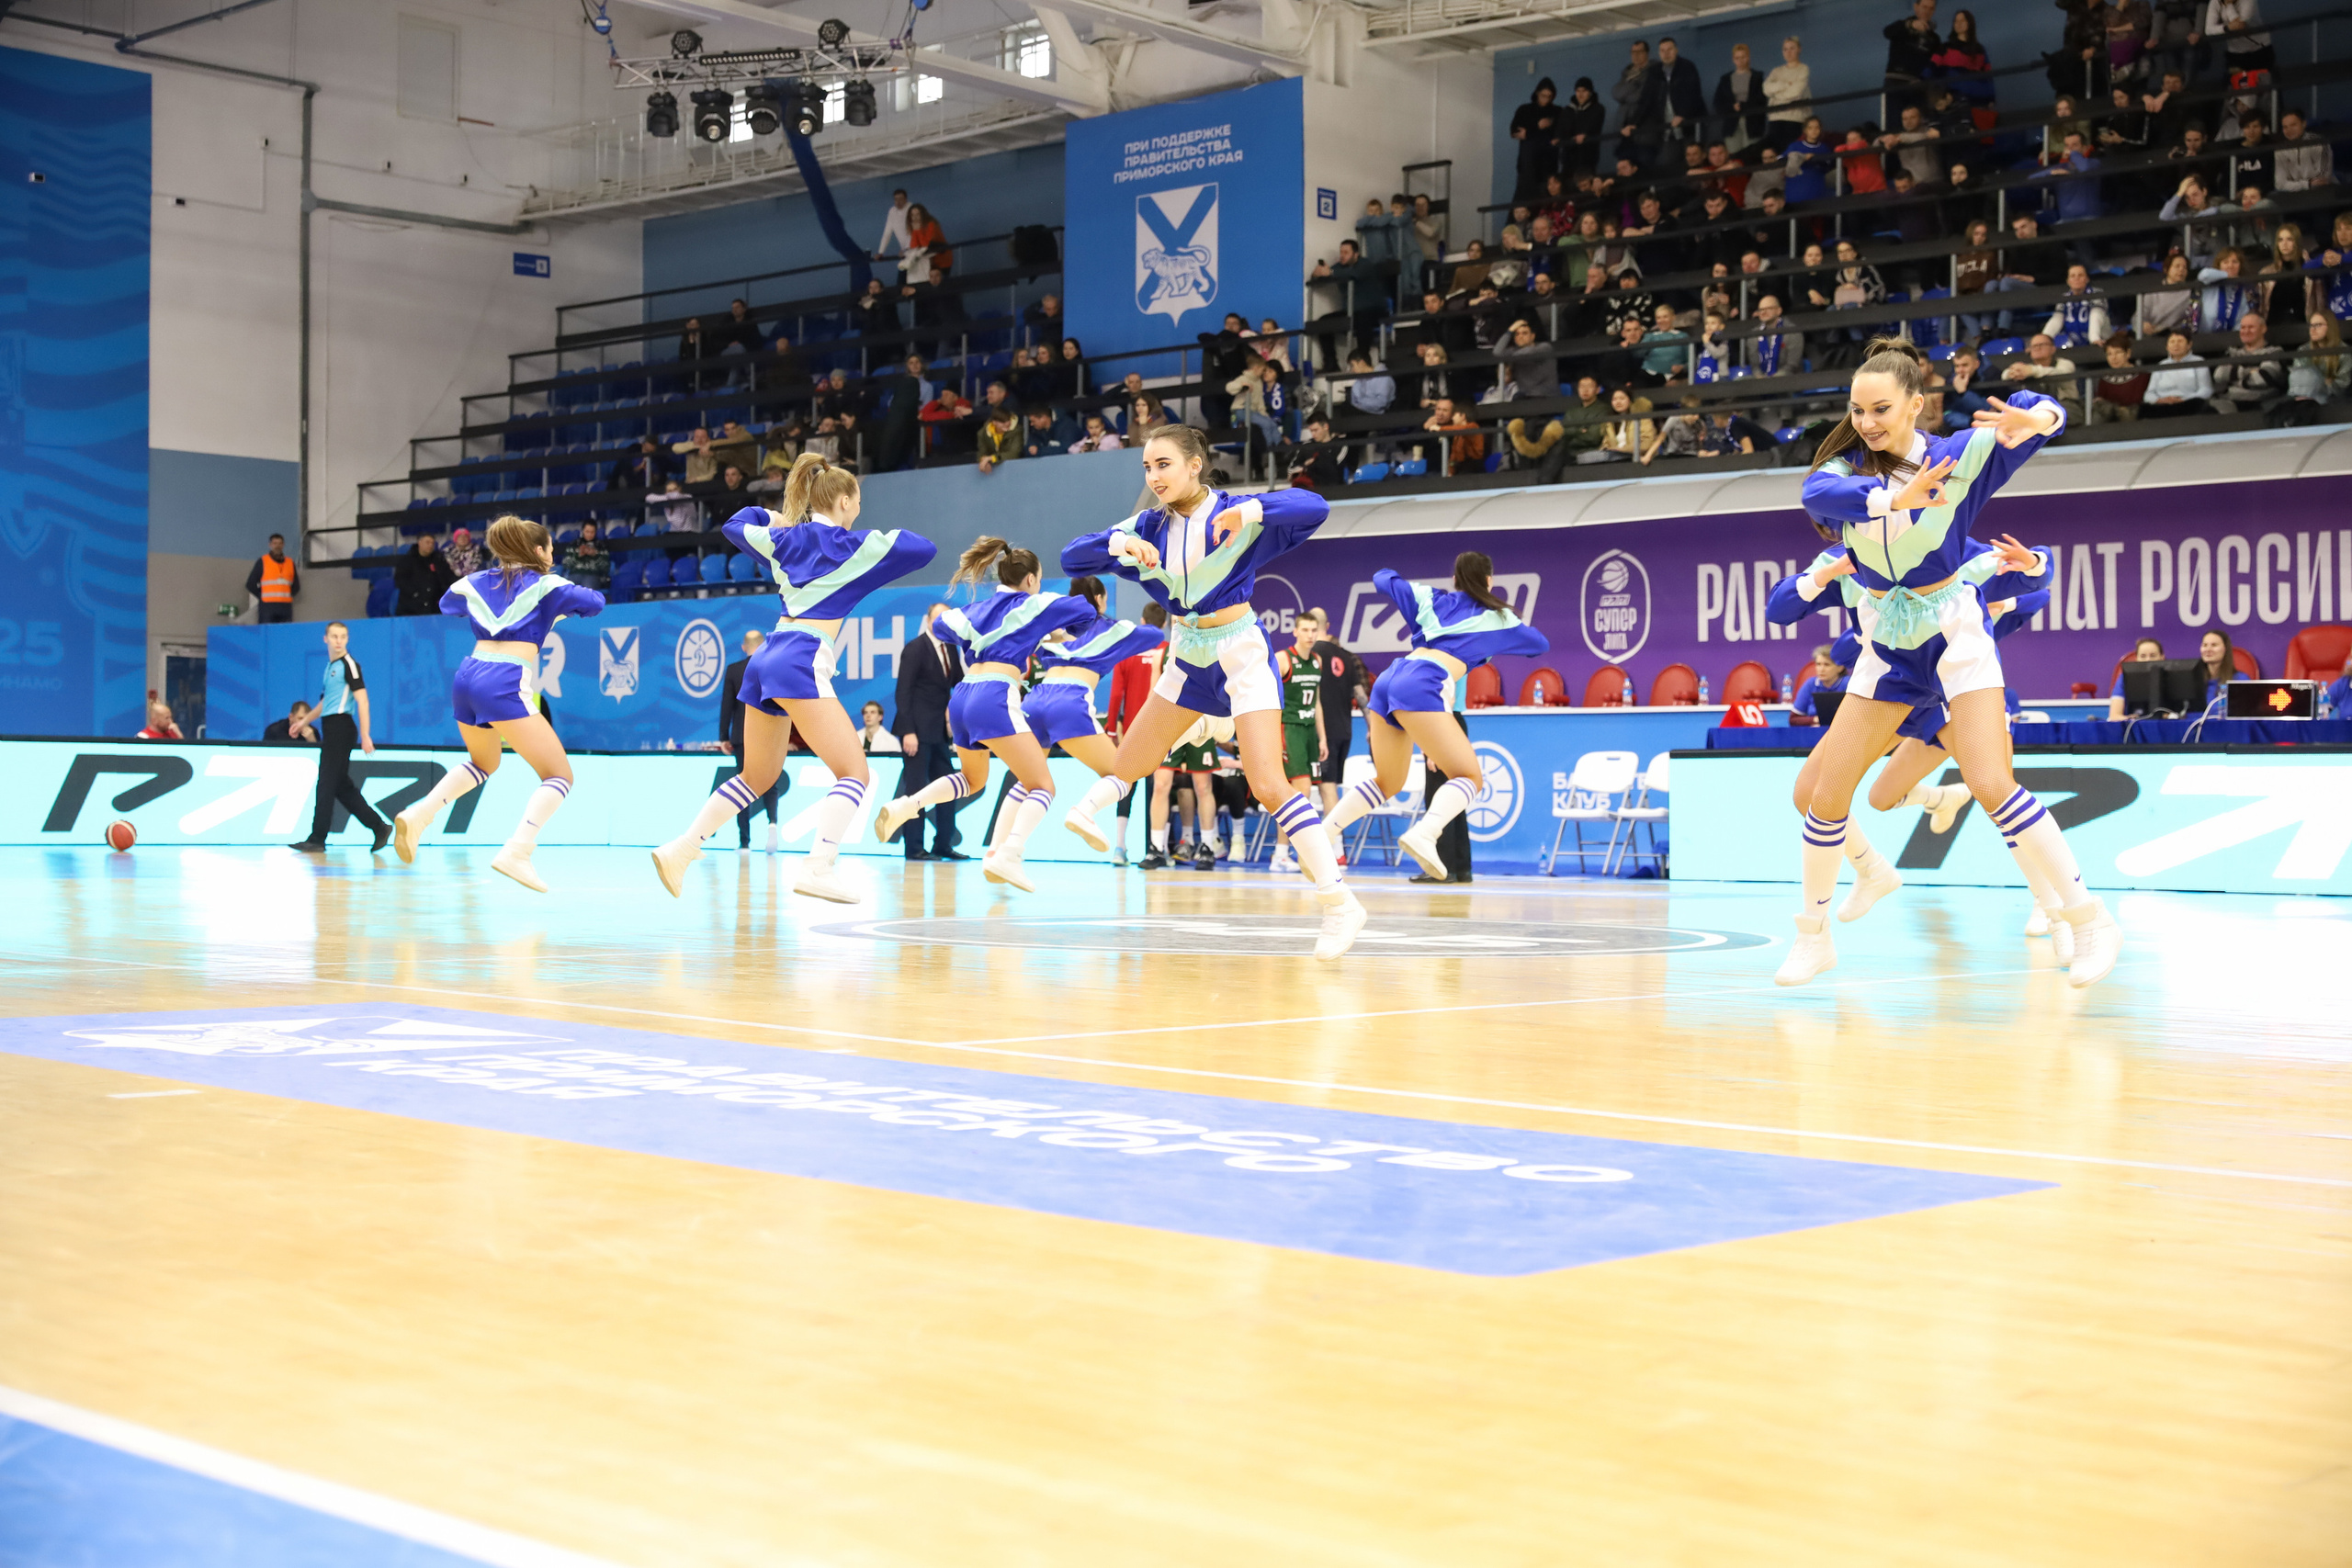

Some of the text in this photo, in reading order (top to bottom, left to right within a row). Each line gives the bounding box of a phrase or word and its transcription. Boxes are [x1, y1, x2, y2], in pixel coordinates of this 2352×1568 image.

[1124, 124, 1231, 155] ПРИ ПОДДЕРЖКЕ
[1124, 139, 1231, 168] ПРАВИТЕЛЬСТВА
[1114, 149, 1243, 184] ПРИМОРСКОГО КРАЯ
[1254, 608, 1295, 634] ФБ
[1594, 607, 1637, 633] СУПЕР
[1302, 690, 1315, 705] 17
[323, 1059, 644, 1100] КРАЯ
[423, 1055, 1352, 1173] ПРИМОРСКОГО
[520, 1049, 1634, 1183] ПРАВИТЕЛЬСТВО
